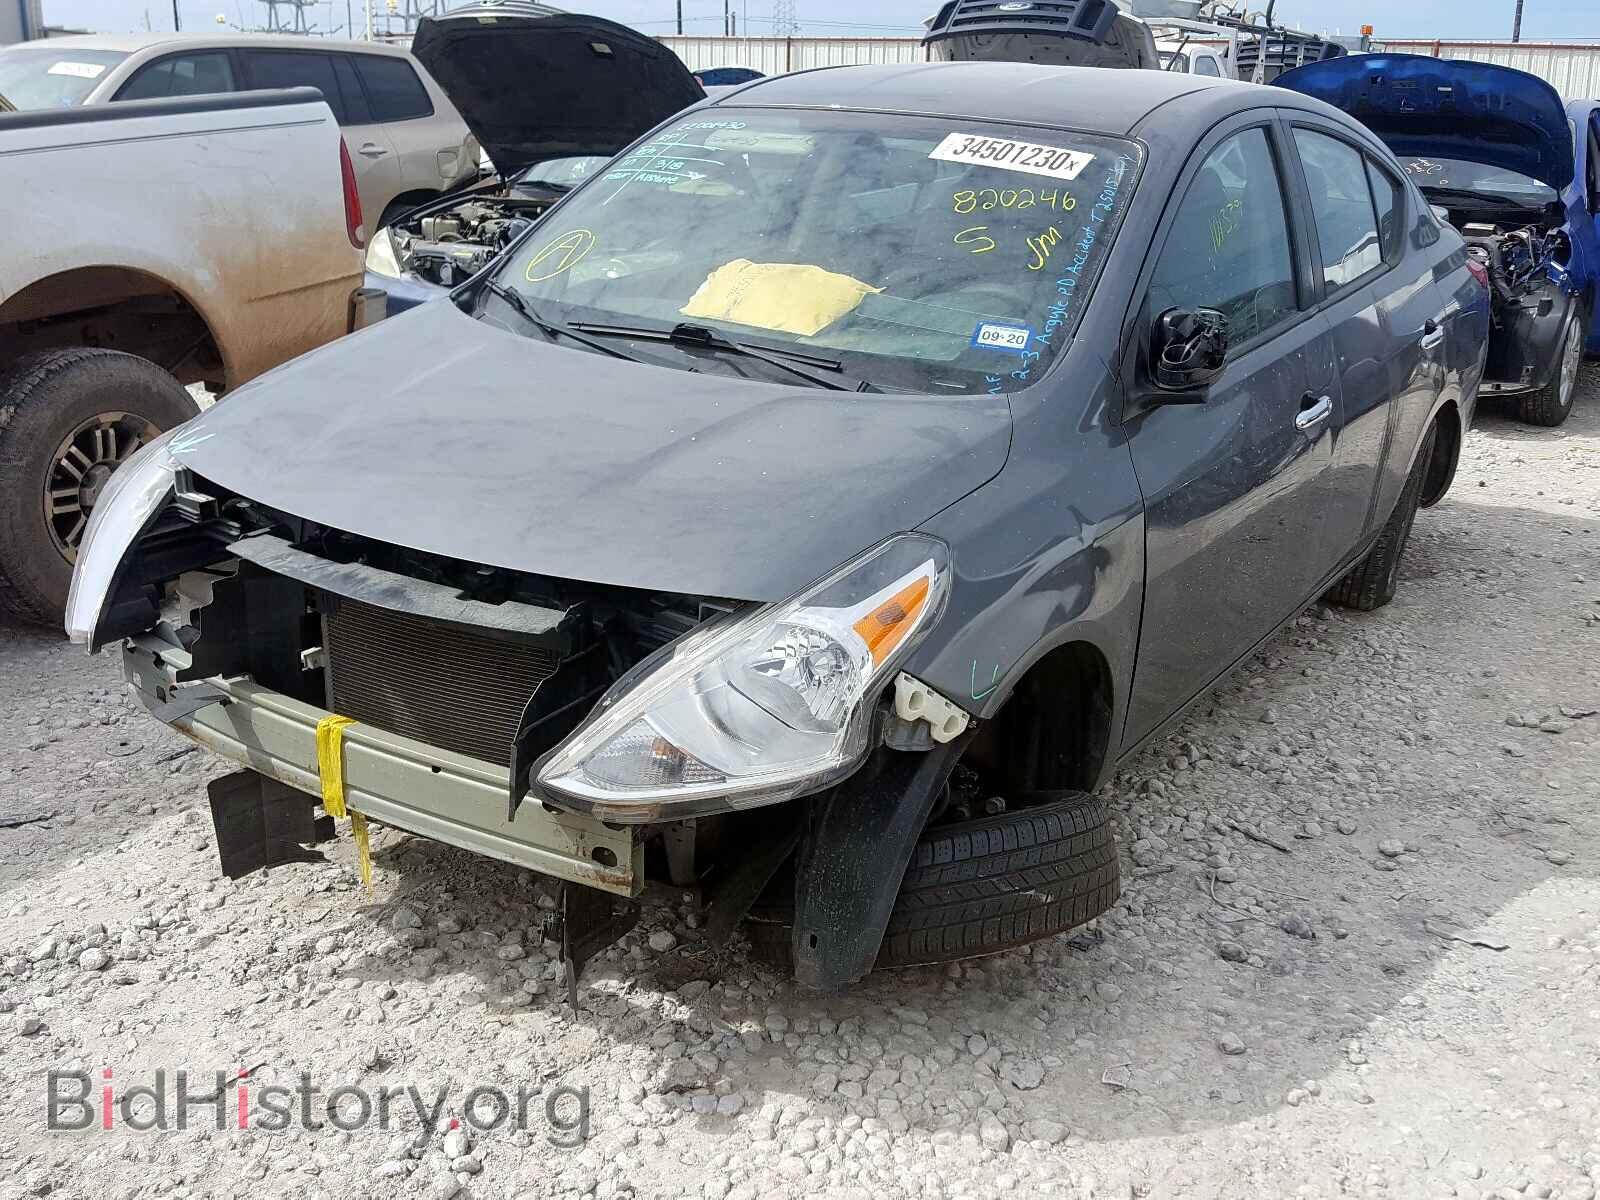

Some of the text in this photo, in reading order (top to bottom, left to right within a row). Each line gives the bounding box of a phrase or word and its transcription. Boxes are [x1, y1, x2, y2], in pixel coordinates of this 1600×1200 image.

[953, 188, 1077, 213] 820246
[1011, 350, 1040, 379] 2-3
[1035, 302, 1069, 345] Argyle
[1065, 225, 1097, 277] Accident
